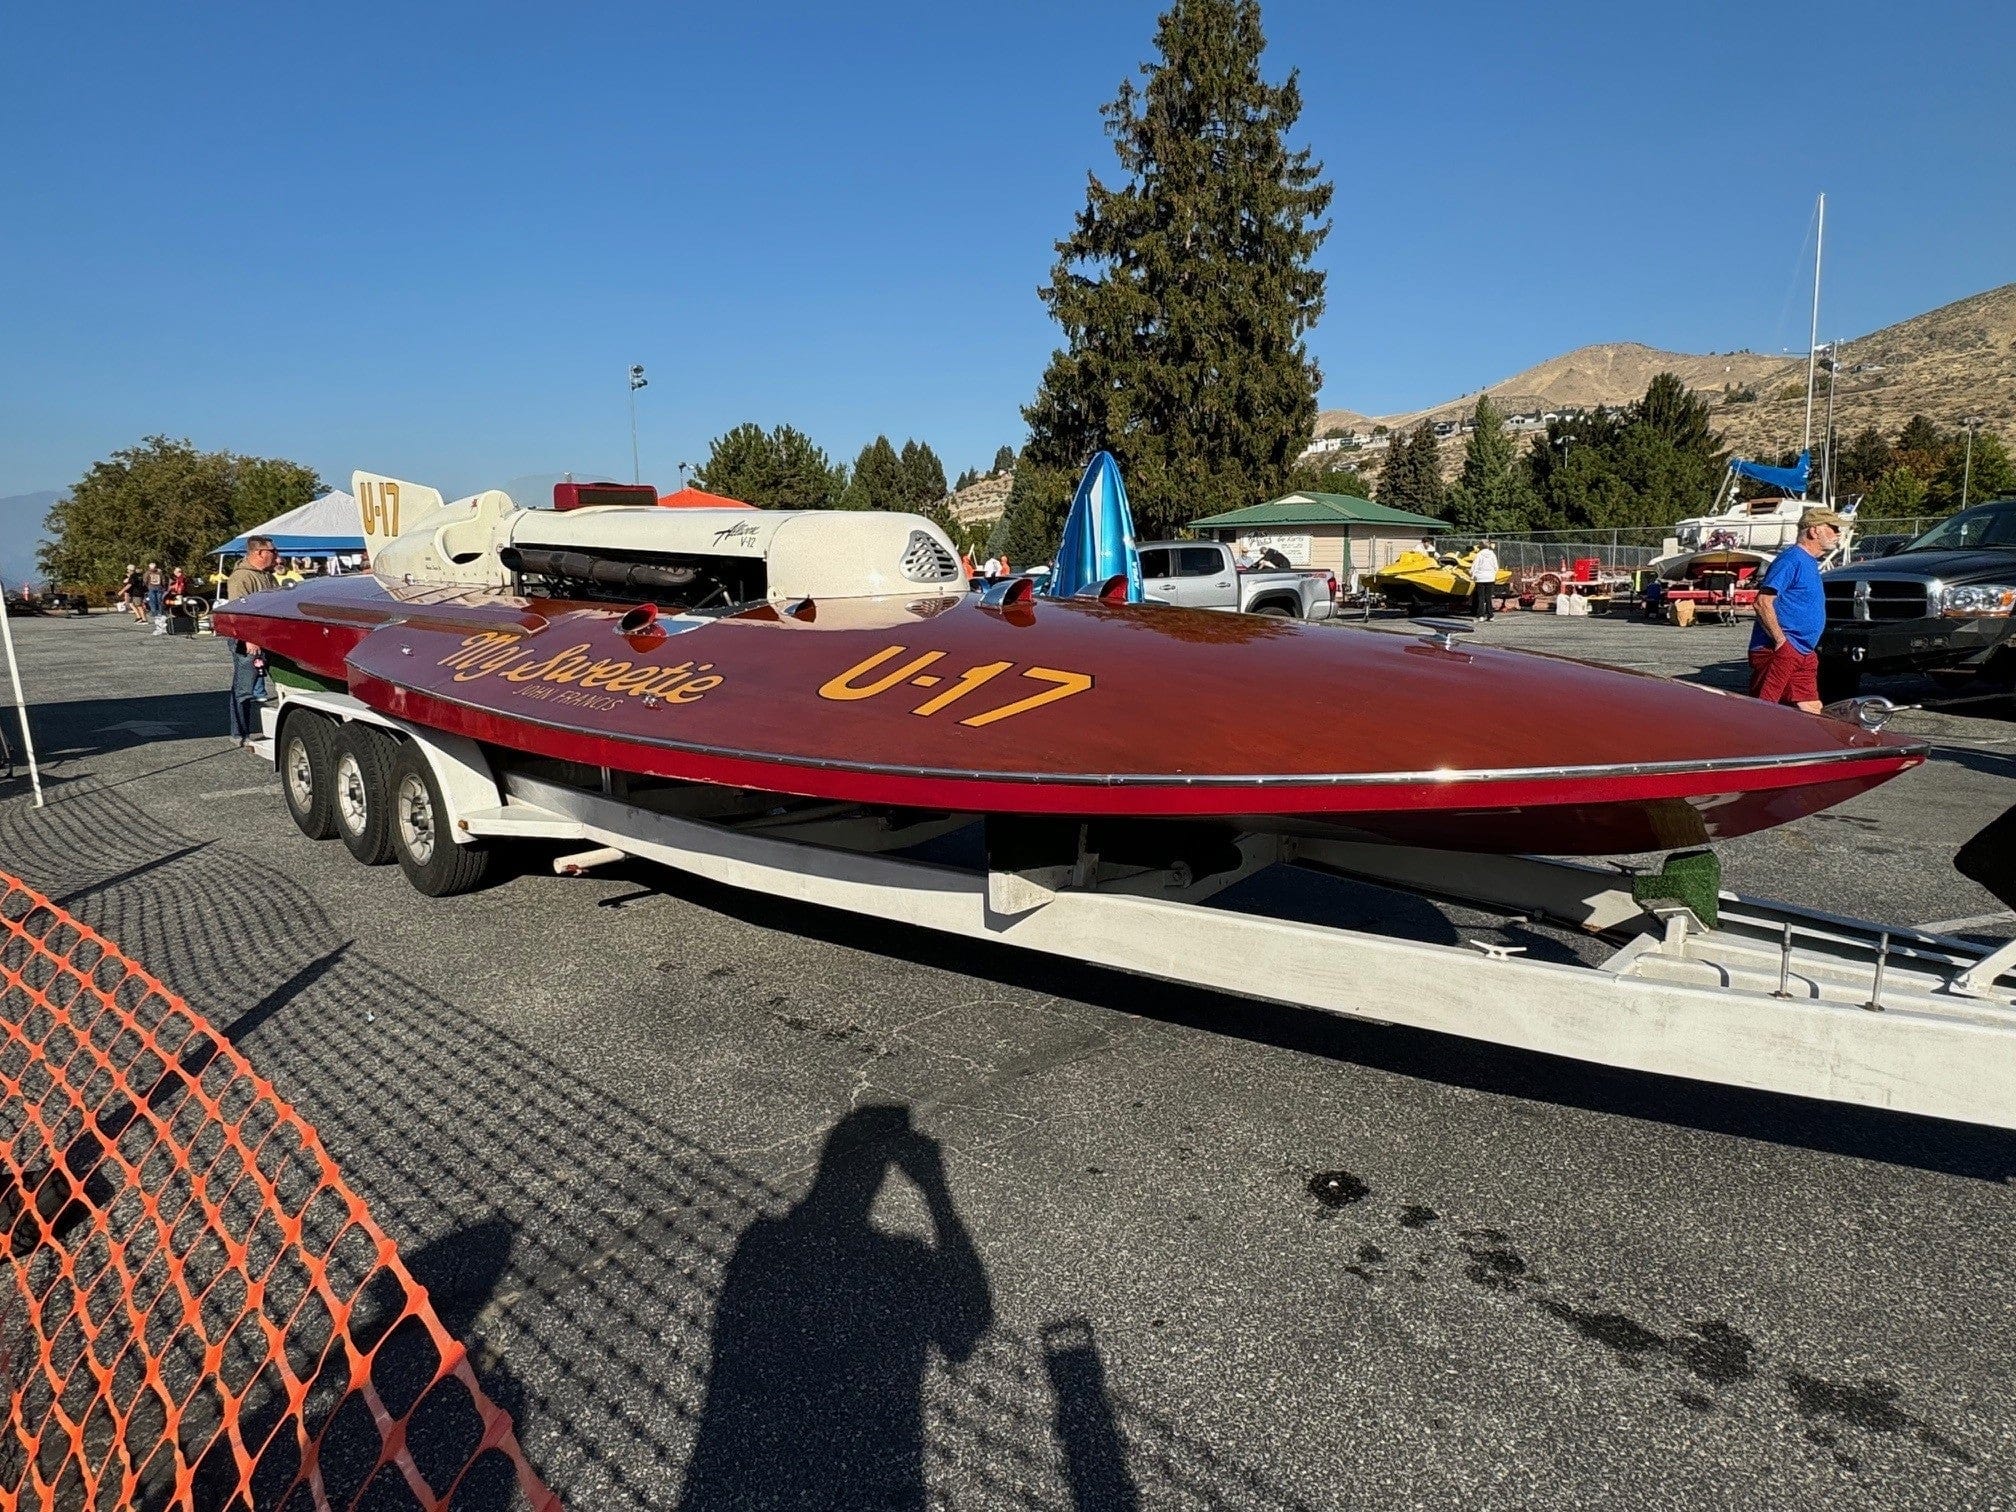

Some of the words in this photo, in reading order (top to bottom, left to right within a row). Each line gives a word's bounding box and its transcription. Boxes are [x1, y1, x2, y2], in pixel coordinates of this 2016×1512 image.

[360, 482, 399, 537] U-17
[437, 631, 535, 682] My
[498, 643, 724, 704] Sweetie
[512, 684, 556, 700] JOHN
[550, 690, 623, 712] FRANCIS
[816, 645, 1095, 728] U-17
